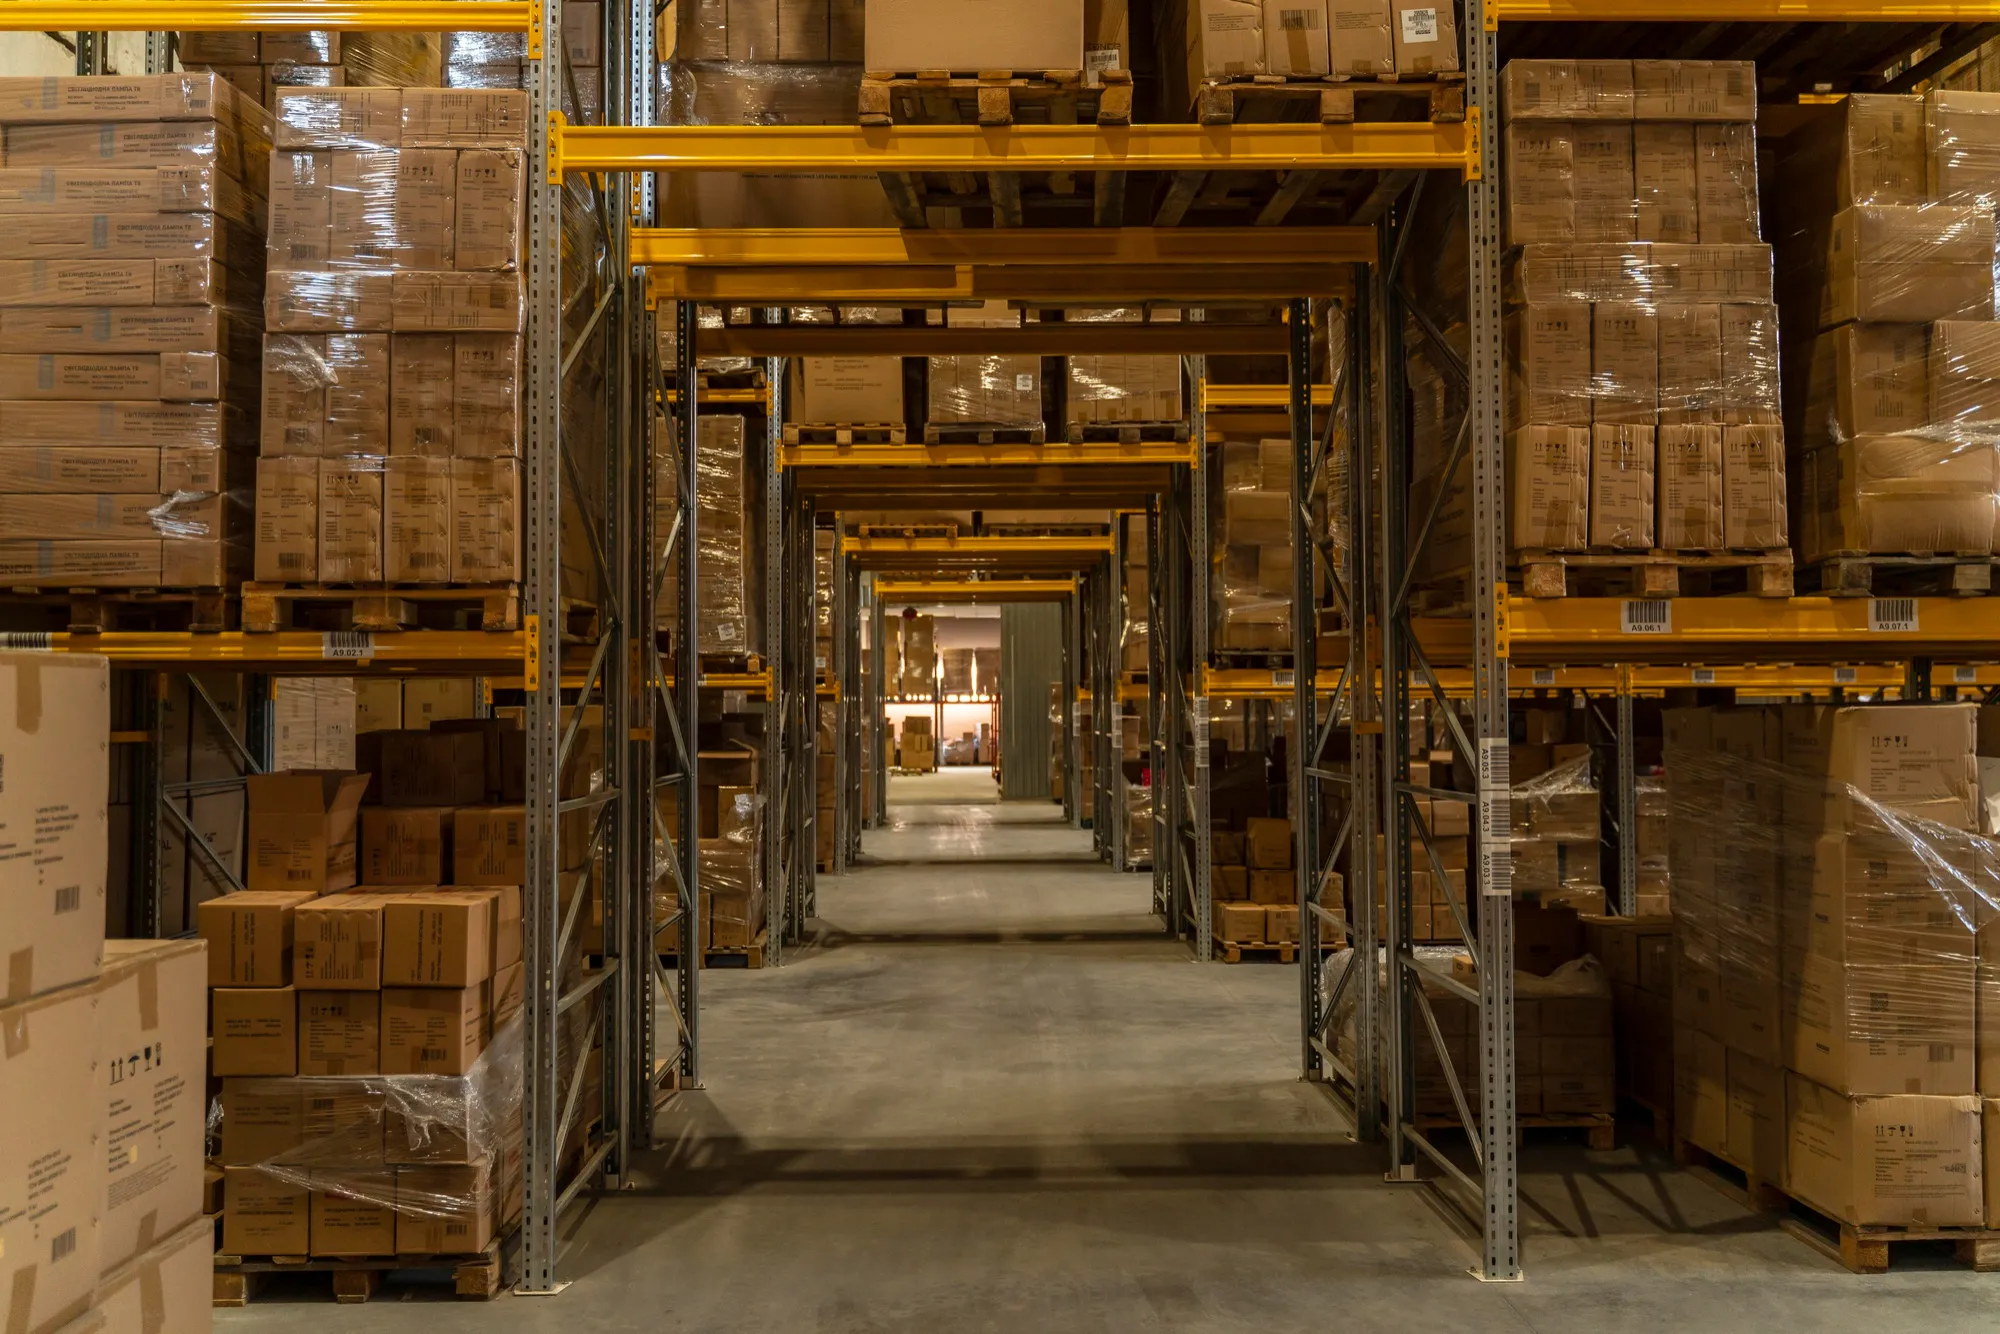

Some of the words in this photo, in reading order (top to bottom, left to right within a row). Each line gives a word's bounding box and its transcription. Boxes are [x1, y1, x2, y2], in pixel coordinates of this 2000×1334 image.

[1631, 624, 1661, 632] A9.06.1
[1879, 622, 1908, 630] A9.07.1
[332, 649, 363, 657] A9.02.1
